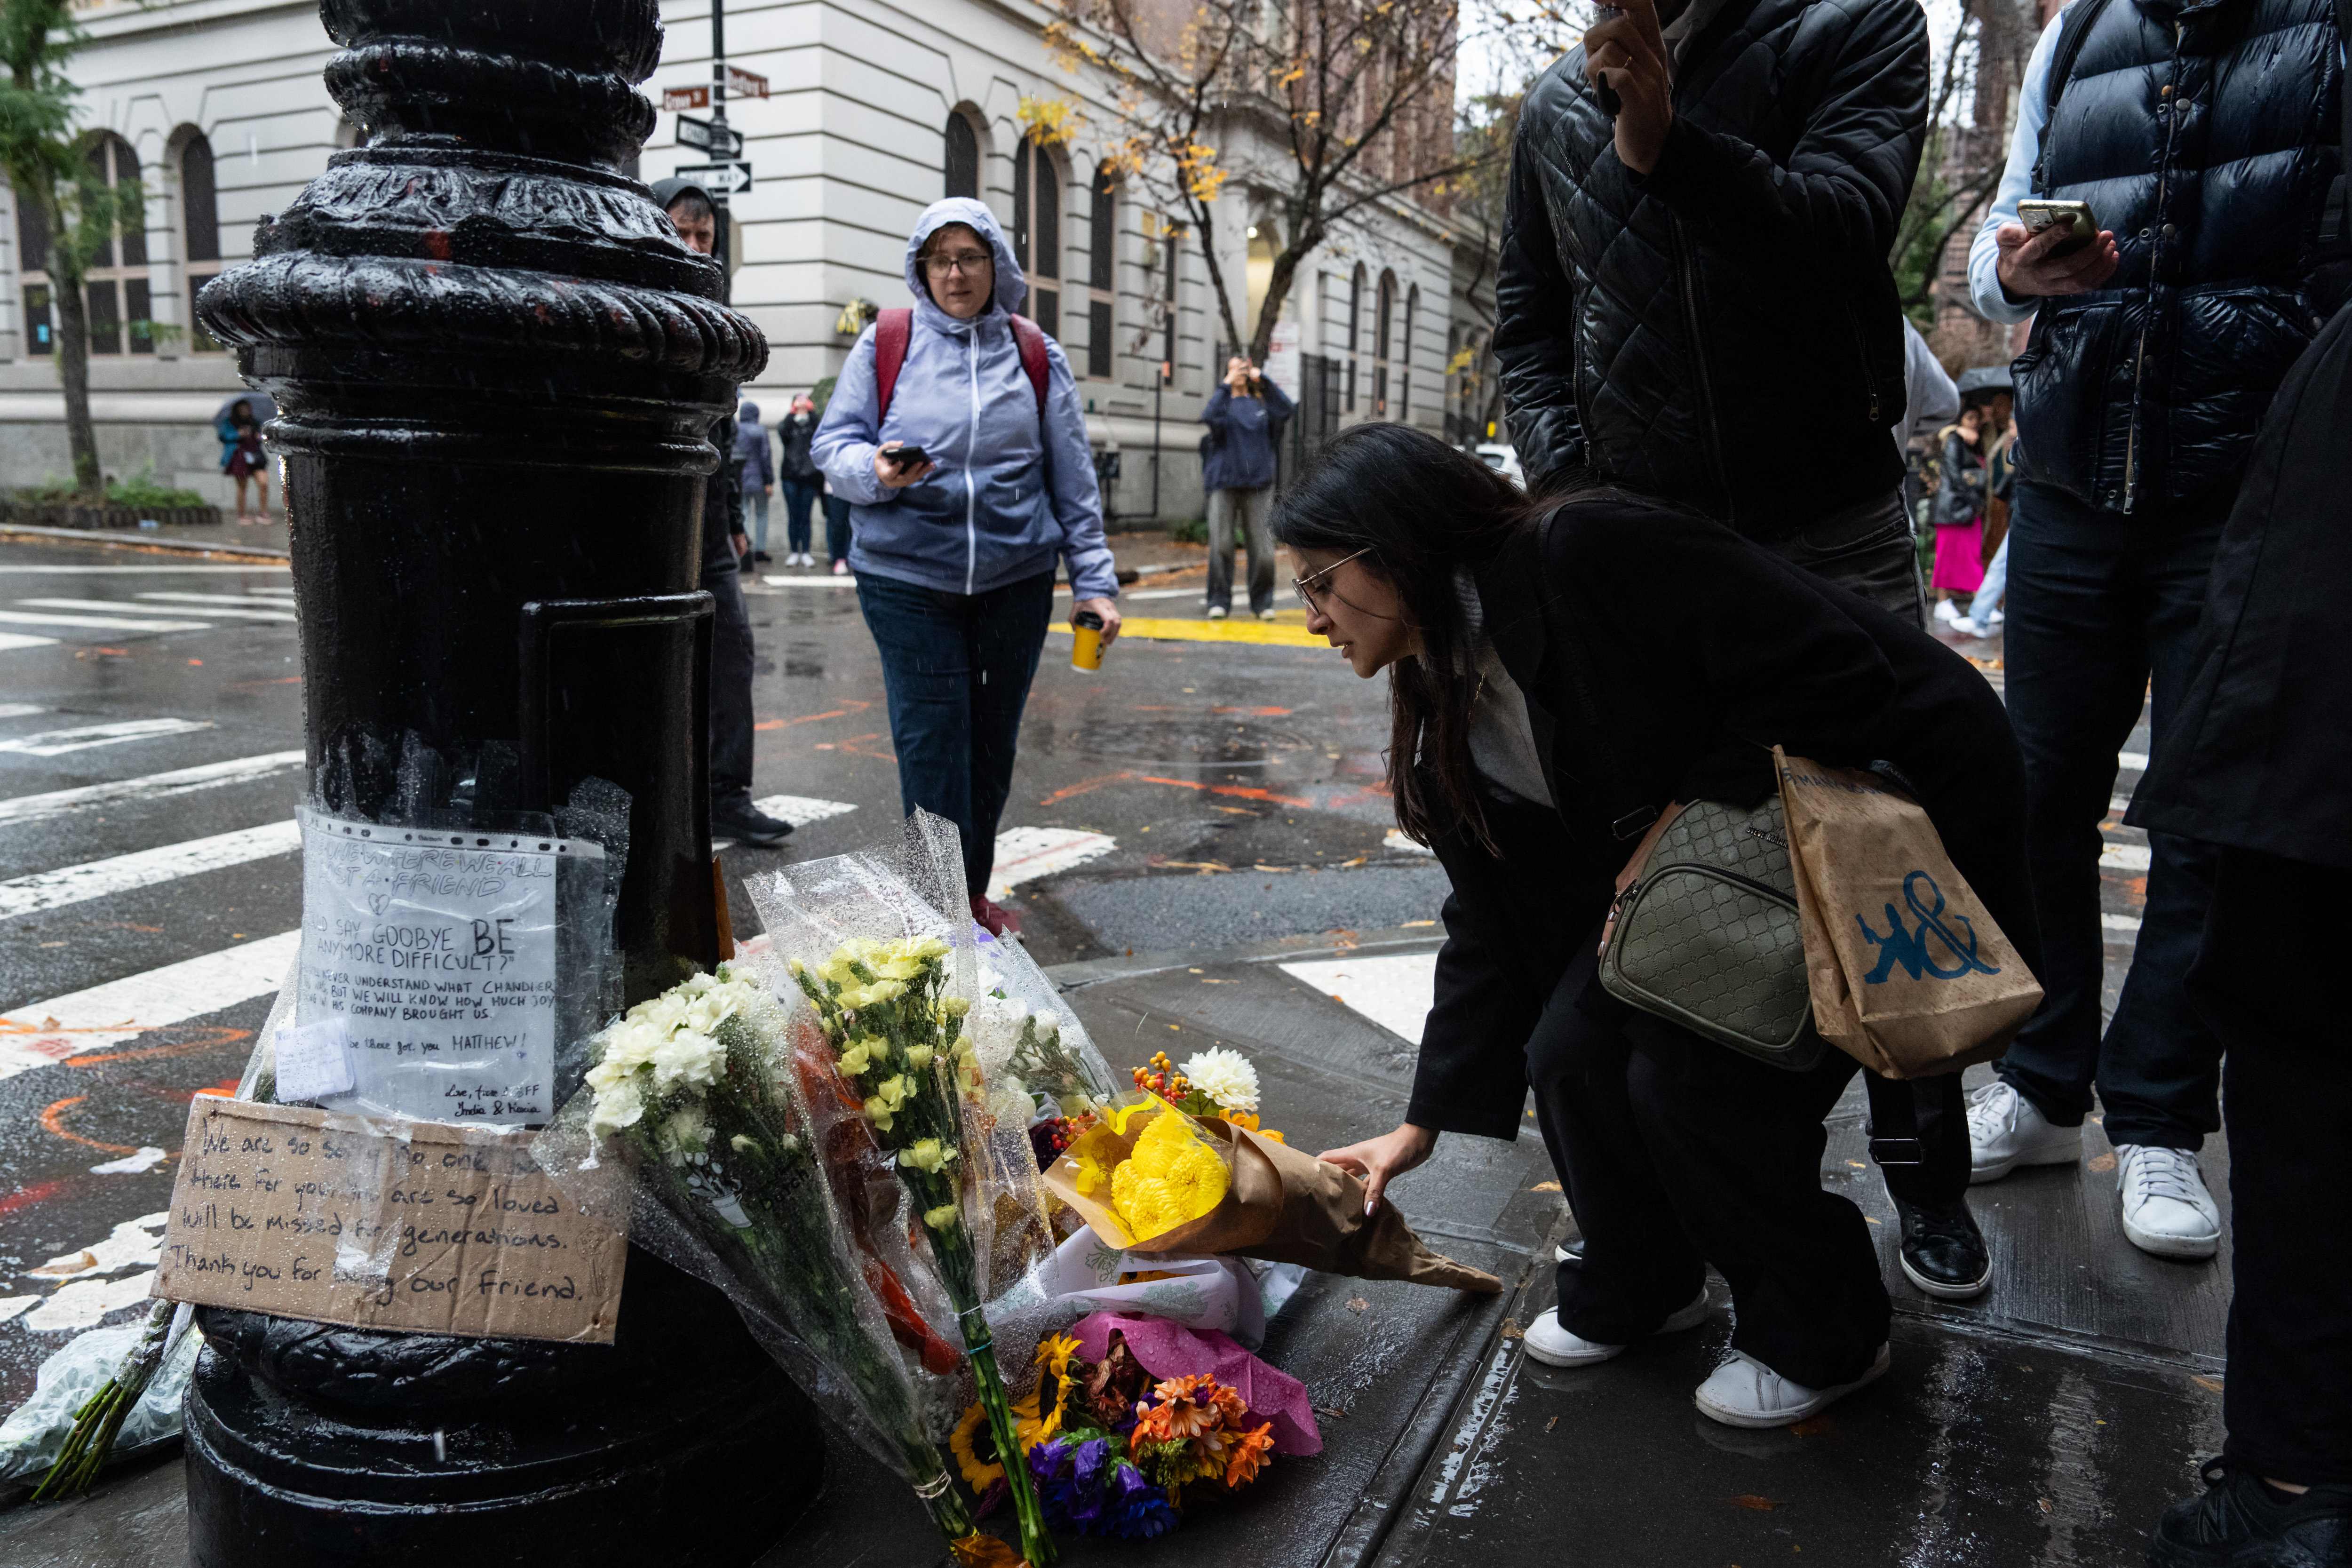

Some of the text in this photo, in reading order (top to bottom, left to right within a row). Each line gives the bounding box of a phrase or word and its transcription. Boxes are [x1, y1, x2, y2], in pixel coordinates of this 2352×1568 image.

[719, 174, 739, 184] WAY
[459, 853, 497, 874] WE
[497, 856, 552, 877] ALL
[391, 872, 506, 897] FRIEND
[336, 919, 362, 939] SAY
[470, 918, 515, 956] BE
[318, 938, 385, 964] ANYMORE
[322, 969, 350, 985] NEVER
[355, 975, 430, 991] UNDERSTAND
[434, 981, 472, 994] WHAT
[483, 981, 556, 994] CHANDLER
[352, 988, 370, 1003] WE
[374, 991, 403, 1003] WILL
[409, 993, 450, 1006] KNOW
[455, 996, 483, 1008] HOW
[491, 995, 527, 1007] MUCH
[532, 995, 556, 1009] JOY
[350, 1003, 397, 1020] COMPANY
[403, 1008, 465, 1021] BROUGHT
[421, 1041, 441, 1055] you
[452, 1032, 527, 1051] MATTHEW!
[493, 1100, 505, 1116] &
[203, 1117, 230, 1156] We
[242, 1136, 273, 1154] are
[287, 1137, 310, 1156] so
[190, 1167, 241, 1191] there
[390, 1189, 434, 1206] are
[446, 1189, 477, 1206] so
[493, 1188, 559, 1214] loved
[231, 1206, 254, 1231] be
[402, 1225, 567, 1257] generations.
[169, 1244, 235, 1276] Thank
[243, 1260, 281, 1292] you
[411, 1276, 459, 1293] our
